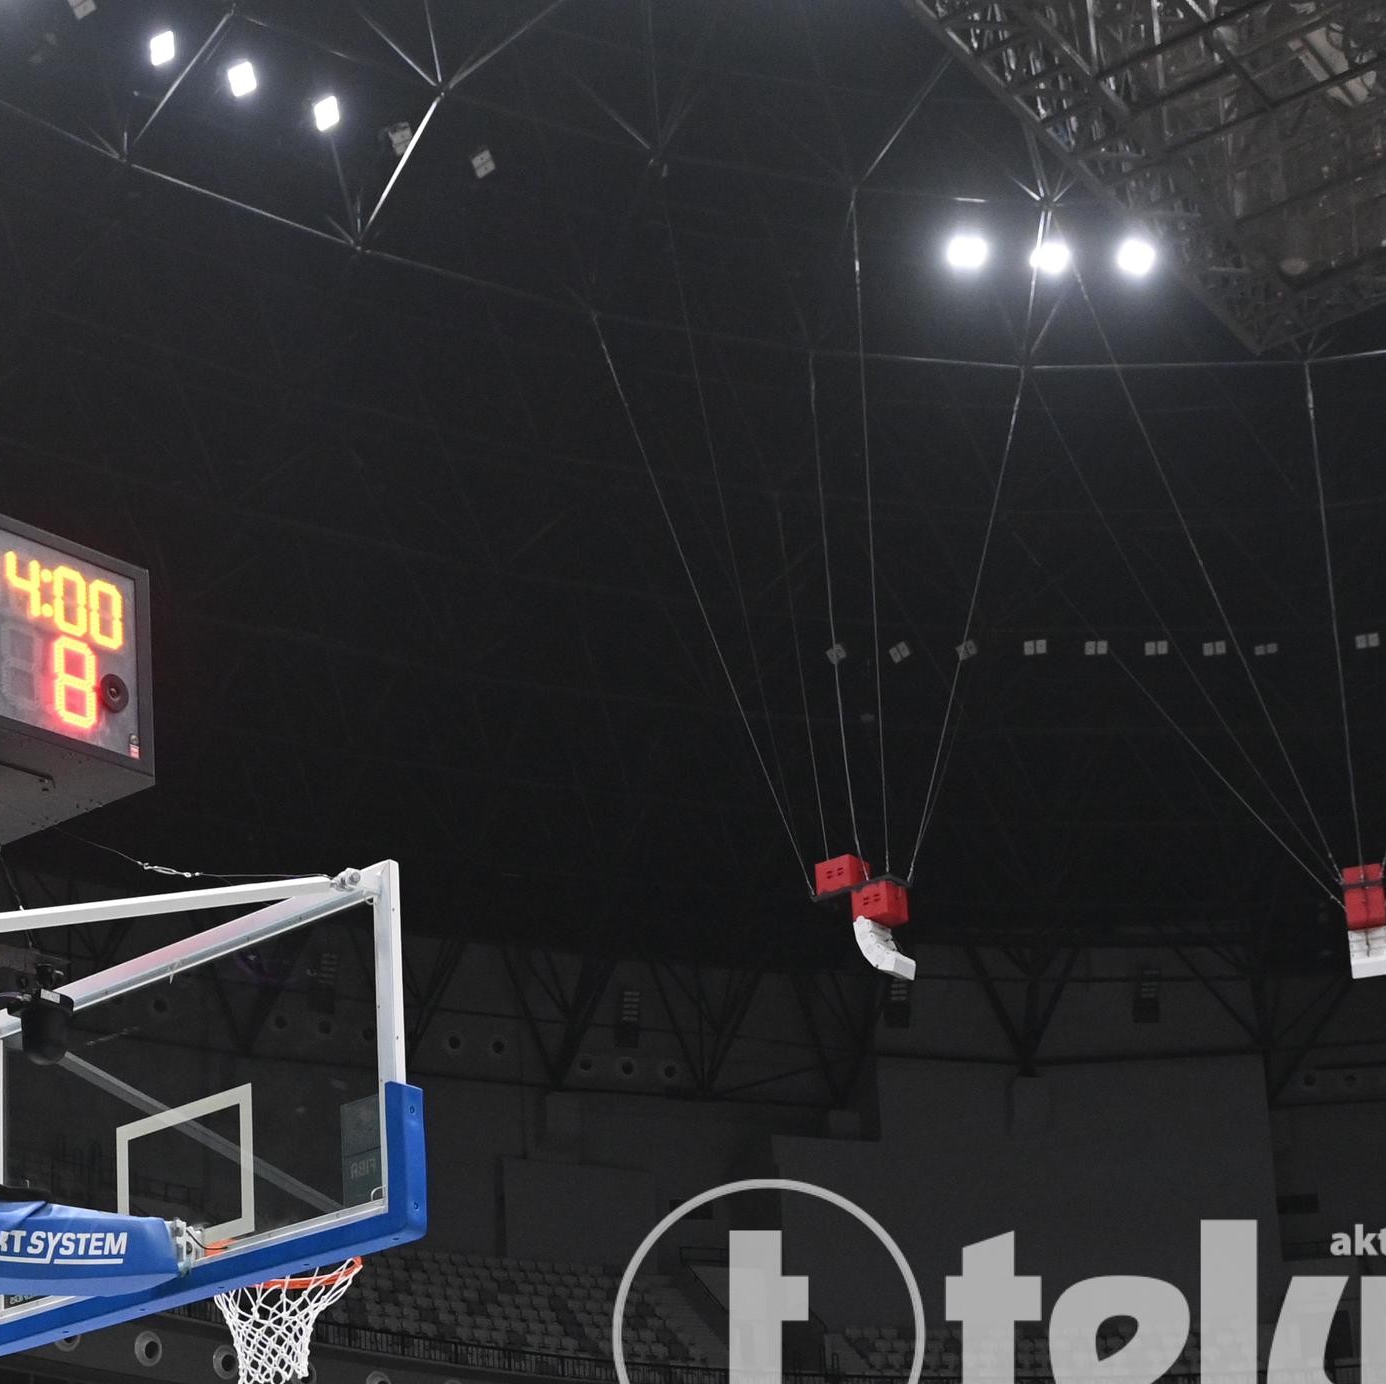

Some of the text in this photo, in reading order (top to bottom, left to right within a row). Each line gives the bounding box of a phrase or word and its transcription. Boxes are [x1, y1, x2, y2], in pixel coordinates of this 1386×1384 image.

[6, 551, 123, 650] 4:00
[53, 635, 98, 729] 8
[26, 1230, 128, 1258] SYSTEM
